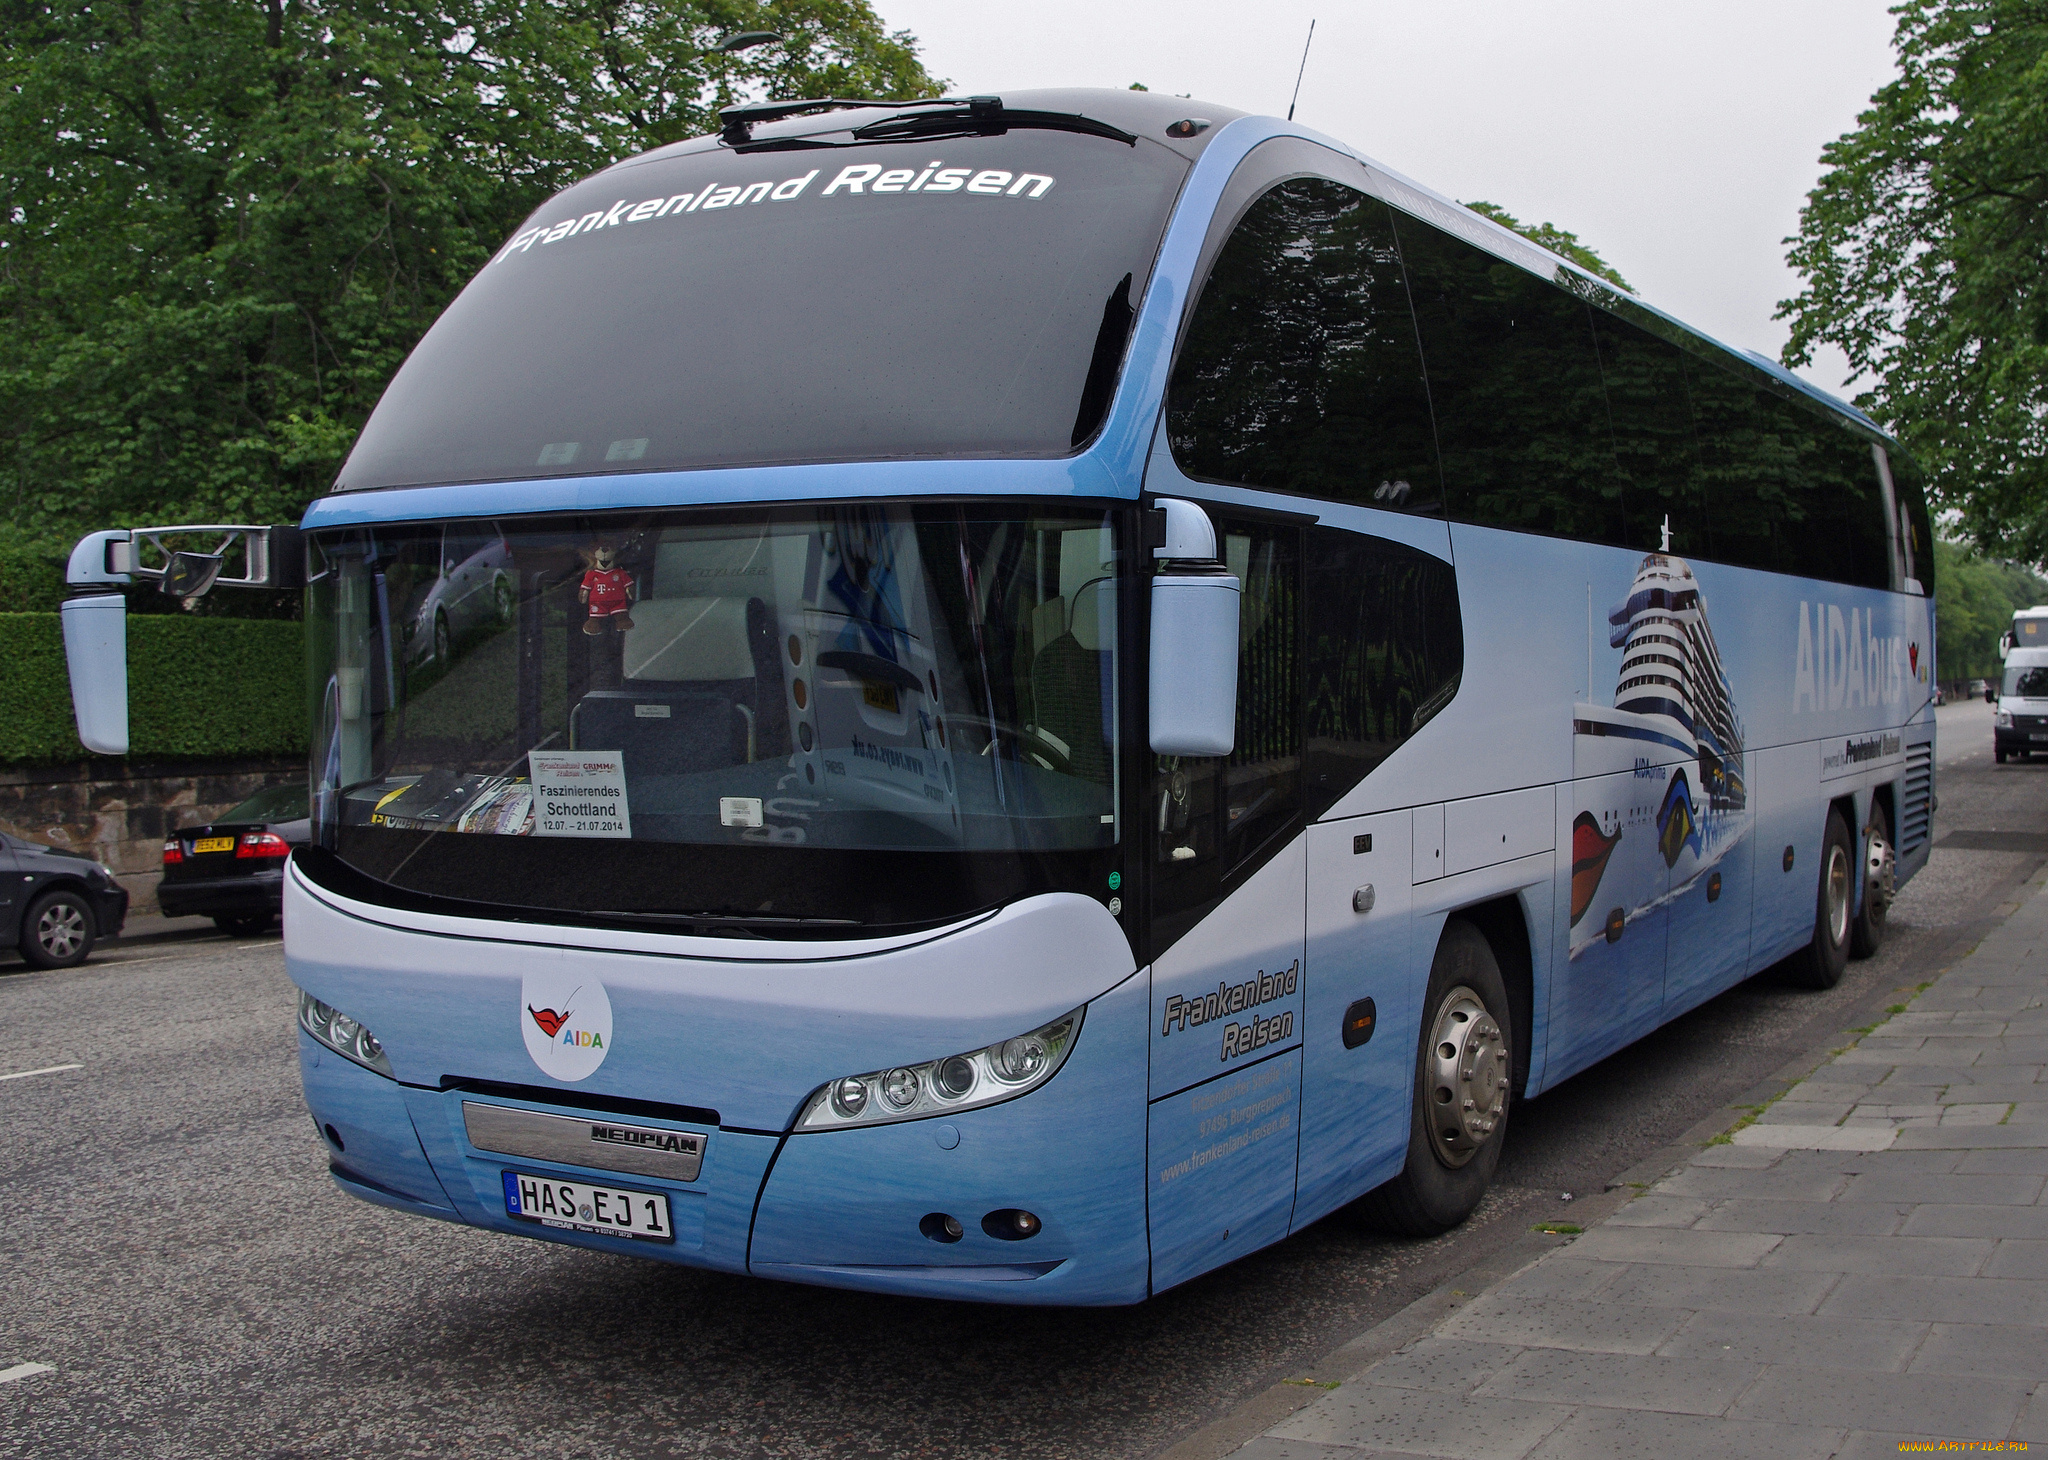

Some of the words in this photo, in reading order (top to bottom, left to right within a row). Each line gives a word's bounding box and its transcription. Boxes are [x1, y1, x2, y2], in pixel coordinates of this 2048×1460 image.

[495, 169, 821, 264] Frankenland
[821, 160, 1055, 198] Reisen
[540, 785, 620, 797] Faszinierendes
[547, 802, 616, 816] Schottland
[543, 821, 567, 830] 12.07.
[577, 821, 623, 831] 21.07.2014
[1162, 959, 1299, 1037] Frankenland
[563, 1030, 604, 1049] AIDA
[1221, 1011, 1293, 1062] Reisen
[592, 1126, 697, 1153] NEOPLAN
[1161, 1113, 1290, 1183] www.frankenland-reisen.de
[510, 1196, 518, 1206] D
[520, 1179, 576, 1218] HAS
[593, 1190, 632, 1227] EJ
[644, 1199, 663, 1232] 1
